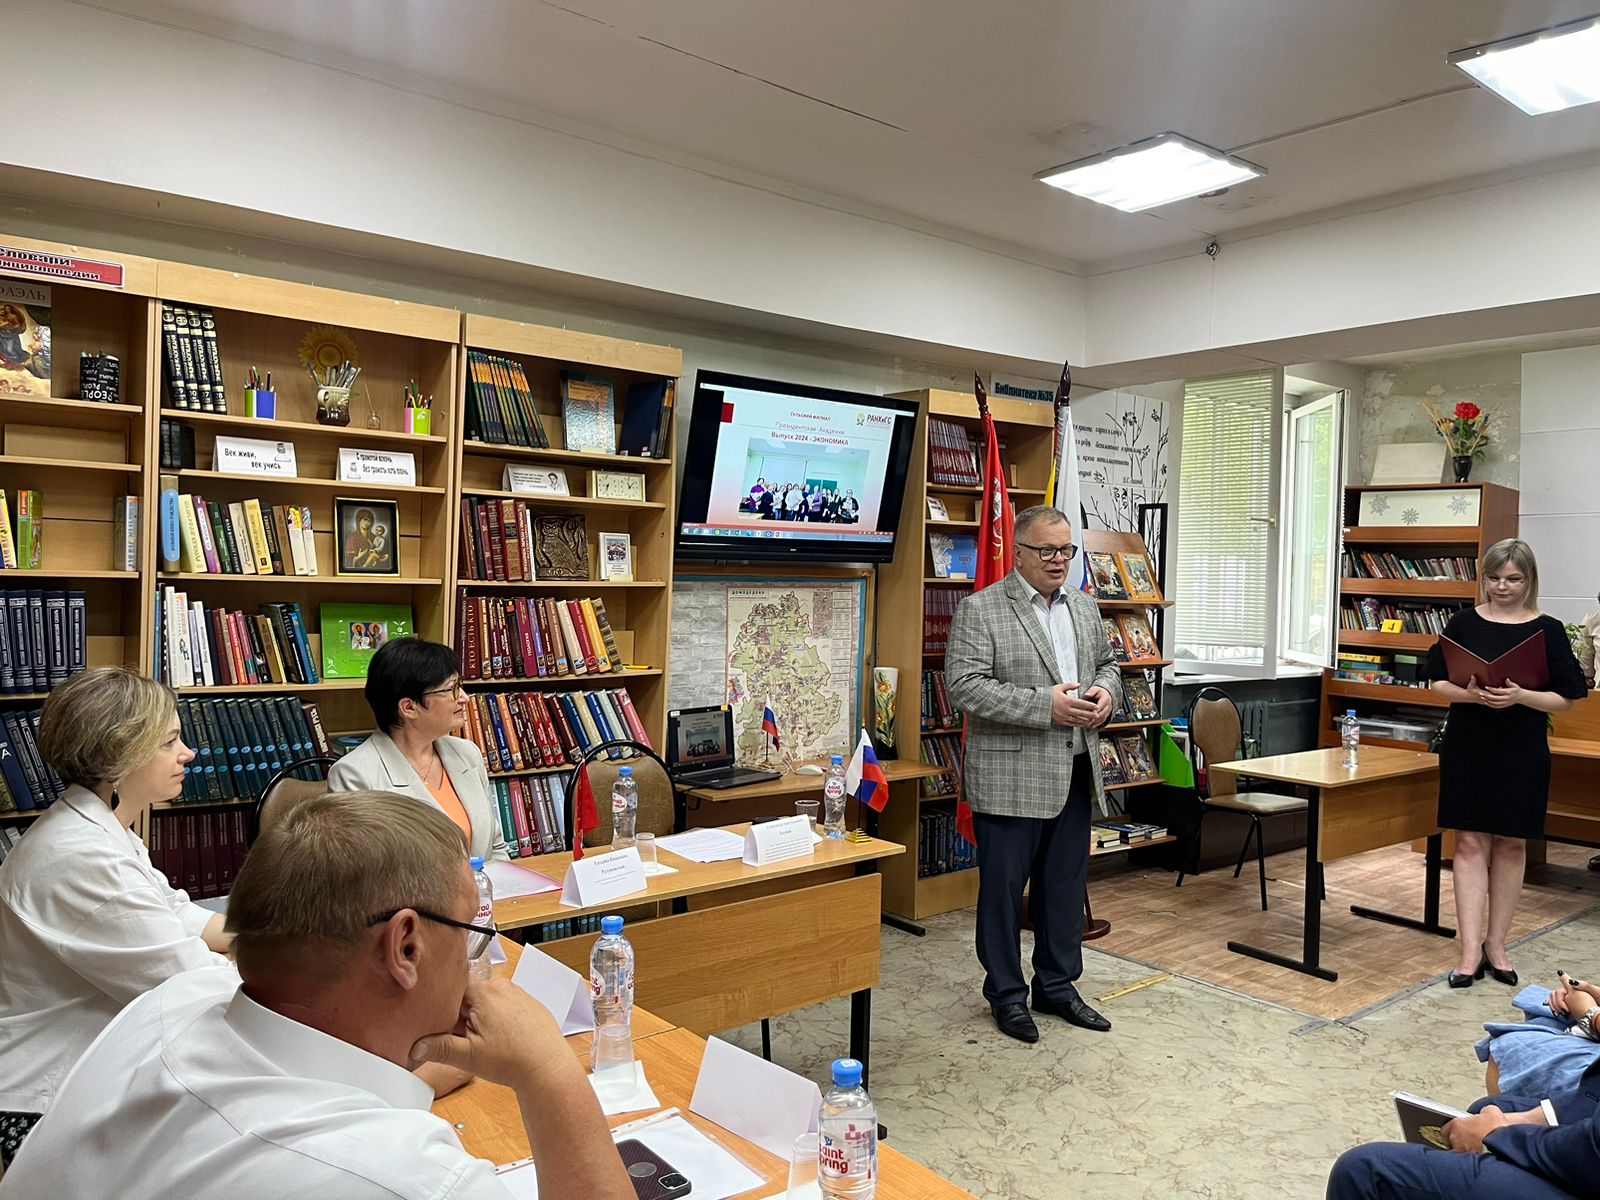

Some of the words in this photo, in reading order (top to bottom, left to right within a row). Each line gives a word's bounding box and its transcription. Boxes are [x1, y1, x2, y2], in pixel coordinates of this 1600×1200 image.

[0, 260, 100, 280] нциклопедии
[994, 382, 1036, 400] Библиотека
[866, 414, 892, 425] РАНХиГС
[775, 421, 816, 432] Президентская
[771, 432, 794, 440] Выпуск
[812, 436, 849, 446] ЭКОНОМИКА
[224, 448, 236, 457] Век
[238, 450, 257, 459] живи,
[264, 462, 281, 470] учись
[1388, 622, 1395, 632] 4
[820, 1146, 844, 1160] aint
[820, 1155, 848, 1174] pring
